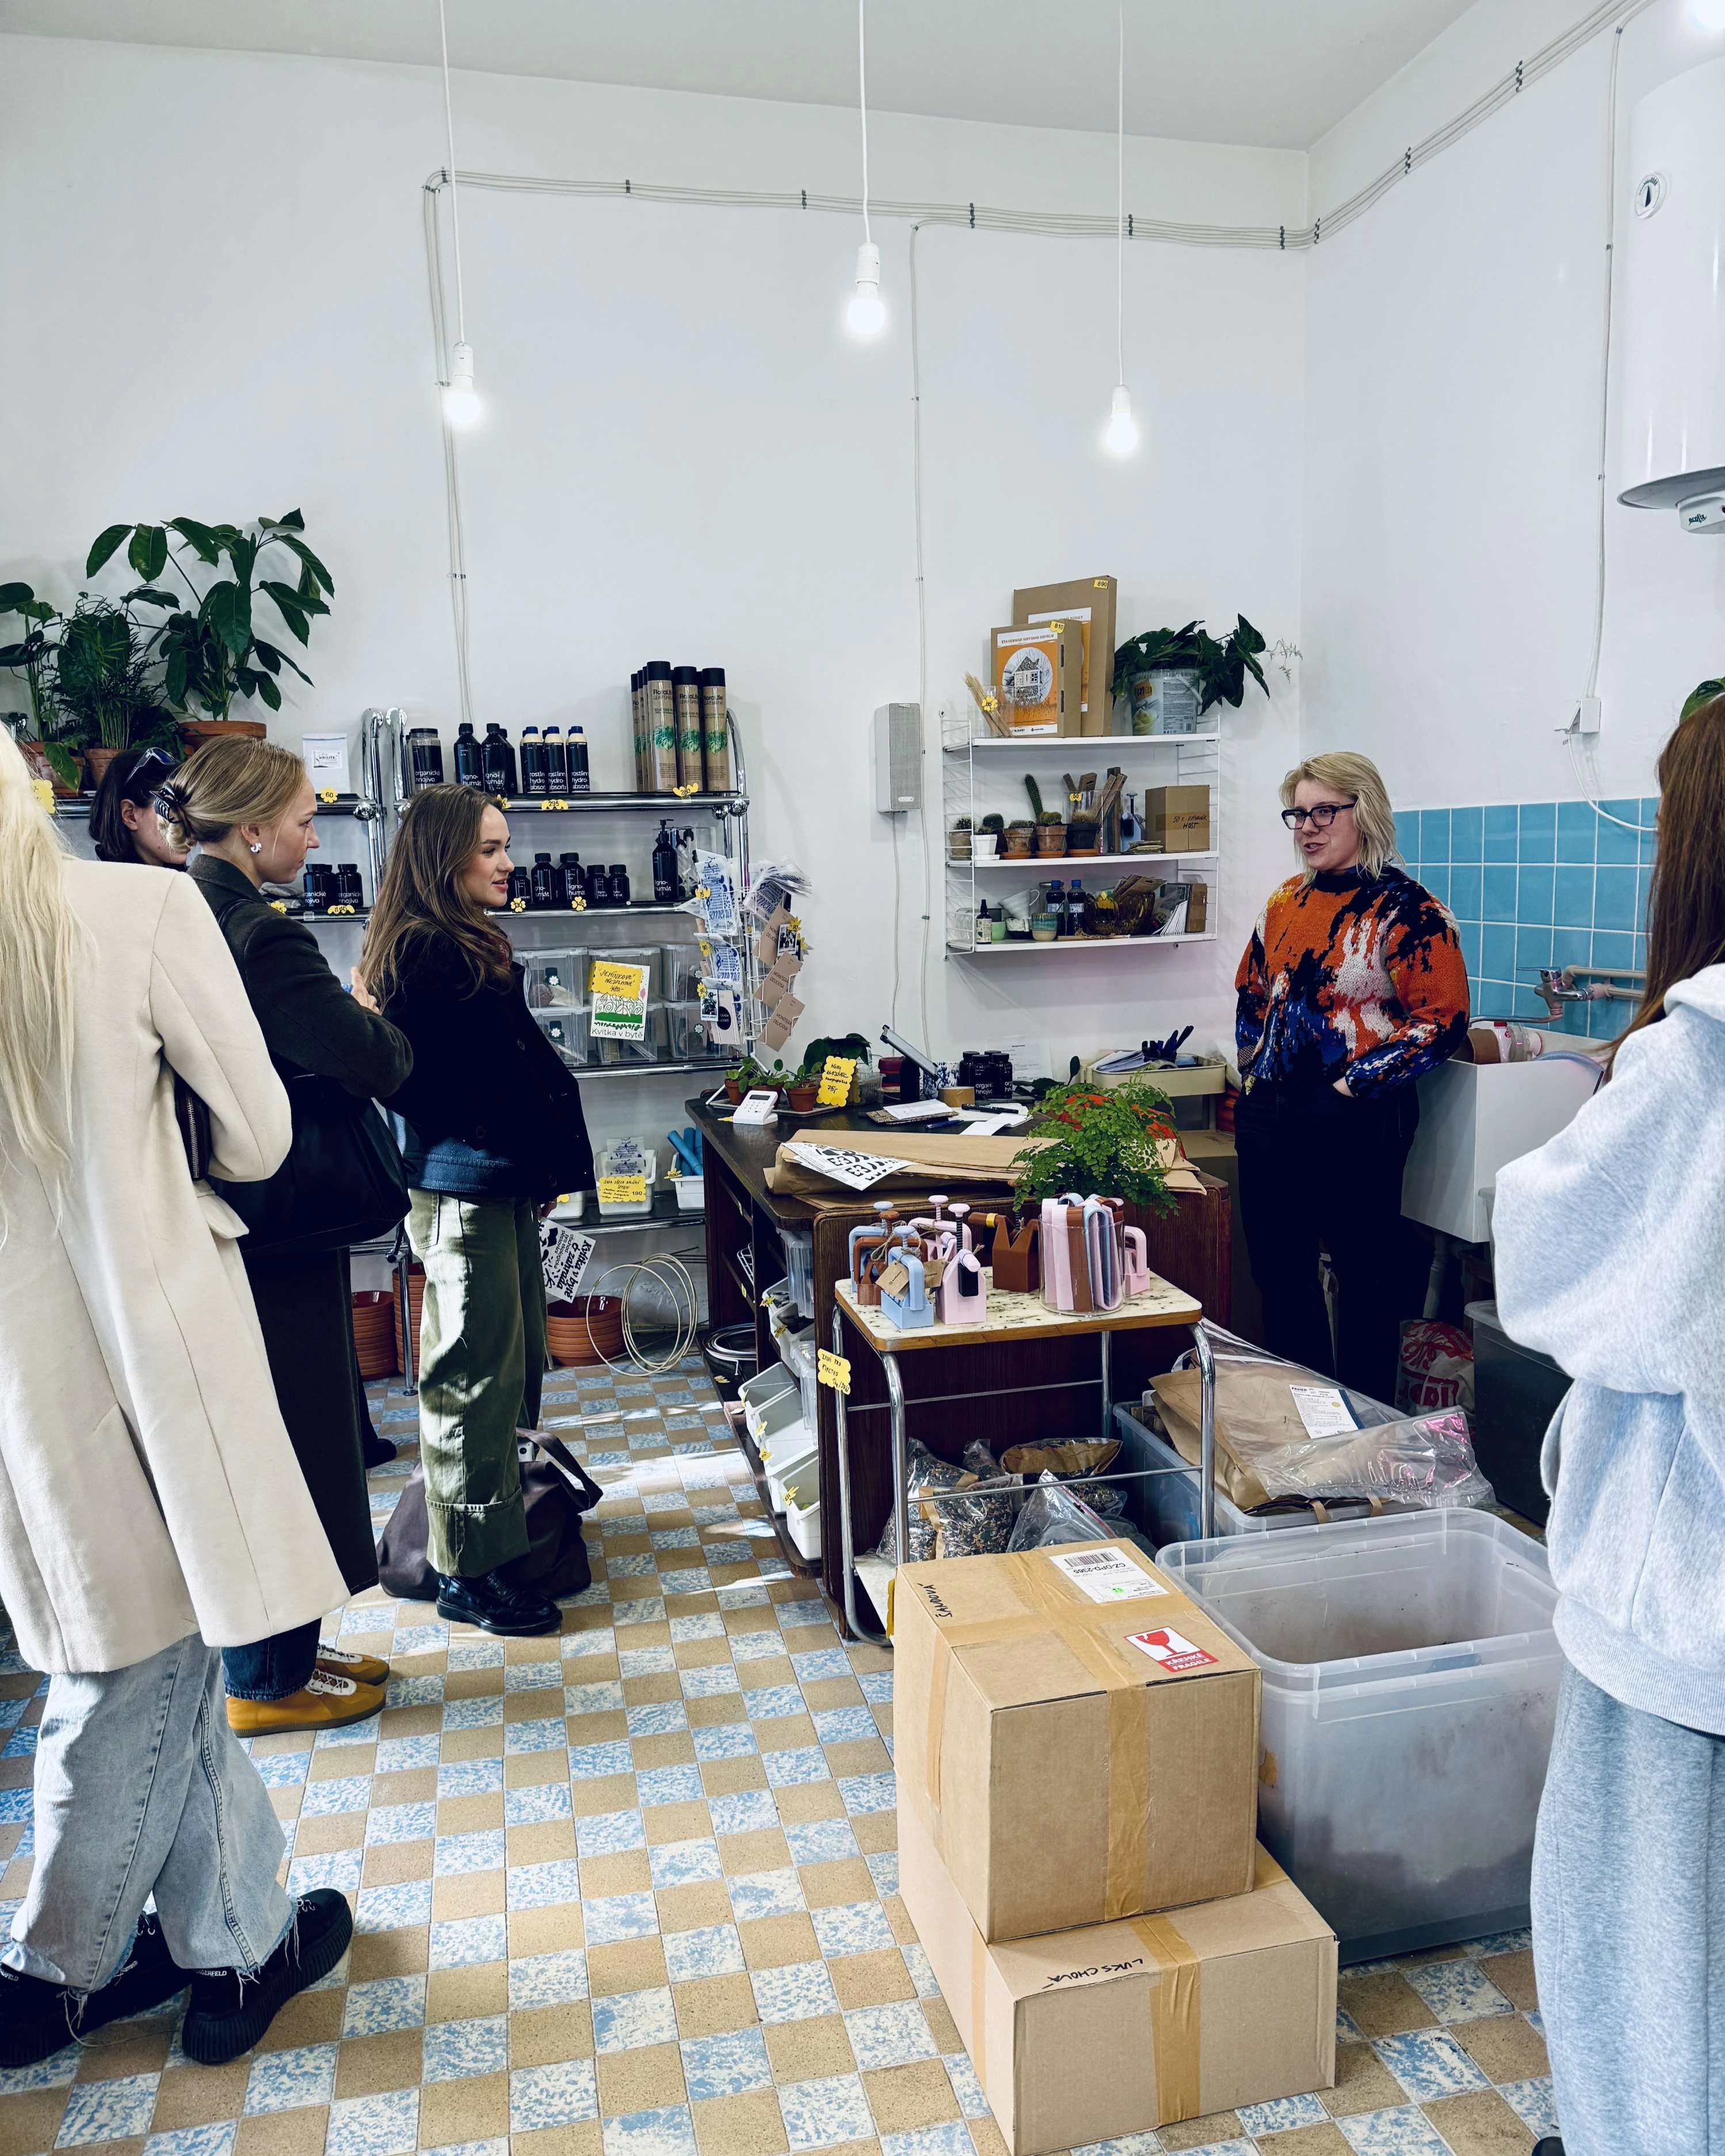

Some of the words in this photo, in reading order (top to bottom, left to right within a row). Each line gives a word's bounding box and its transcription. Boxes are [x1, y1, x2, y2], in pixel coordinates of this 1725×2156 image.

[591, 1028, 616, 1036] Kvítka
[564, 1234, 574, 1253] obchod
[574, 1240, 592, 1271] Kvítka
[556, 1251, 575, 1290] zahrada
[564, 1277, 578, 1299] bytě
[1165, 1652, 1205, 1665] KŘEHKÉ
[1171, 1658, 1212, 1670] FRAGILE
